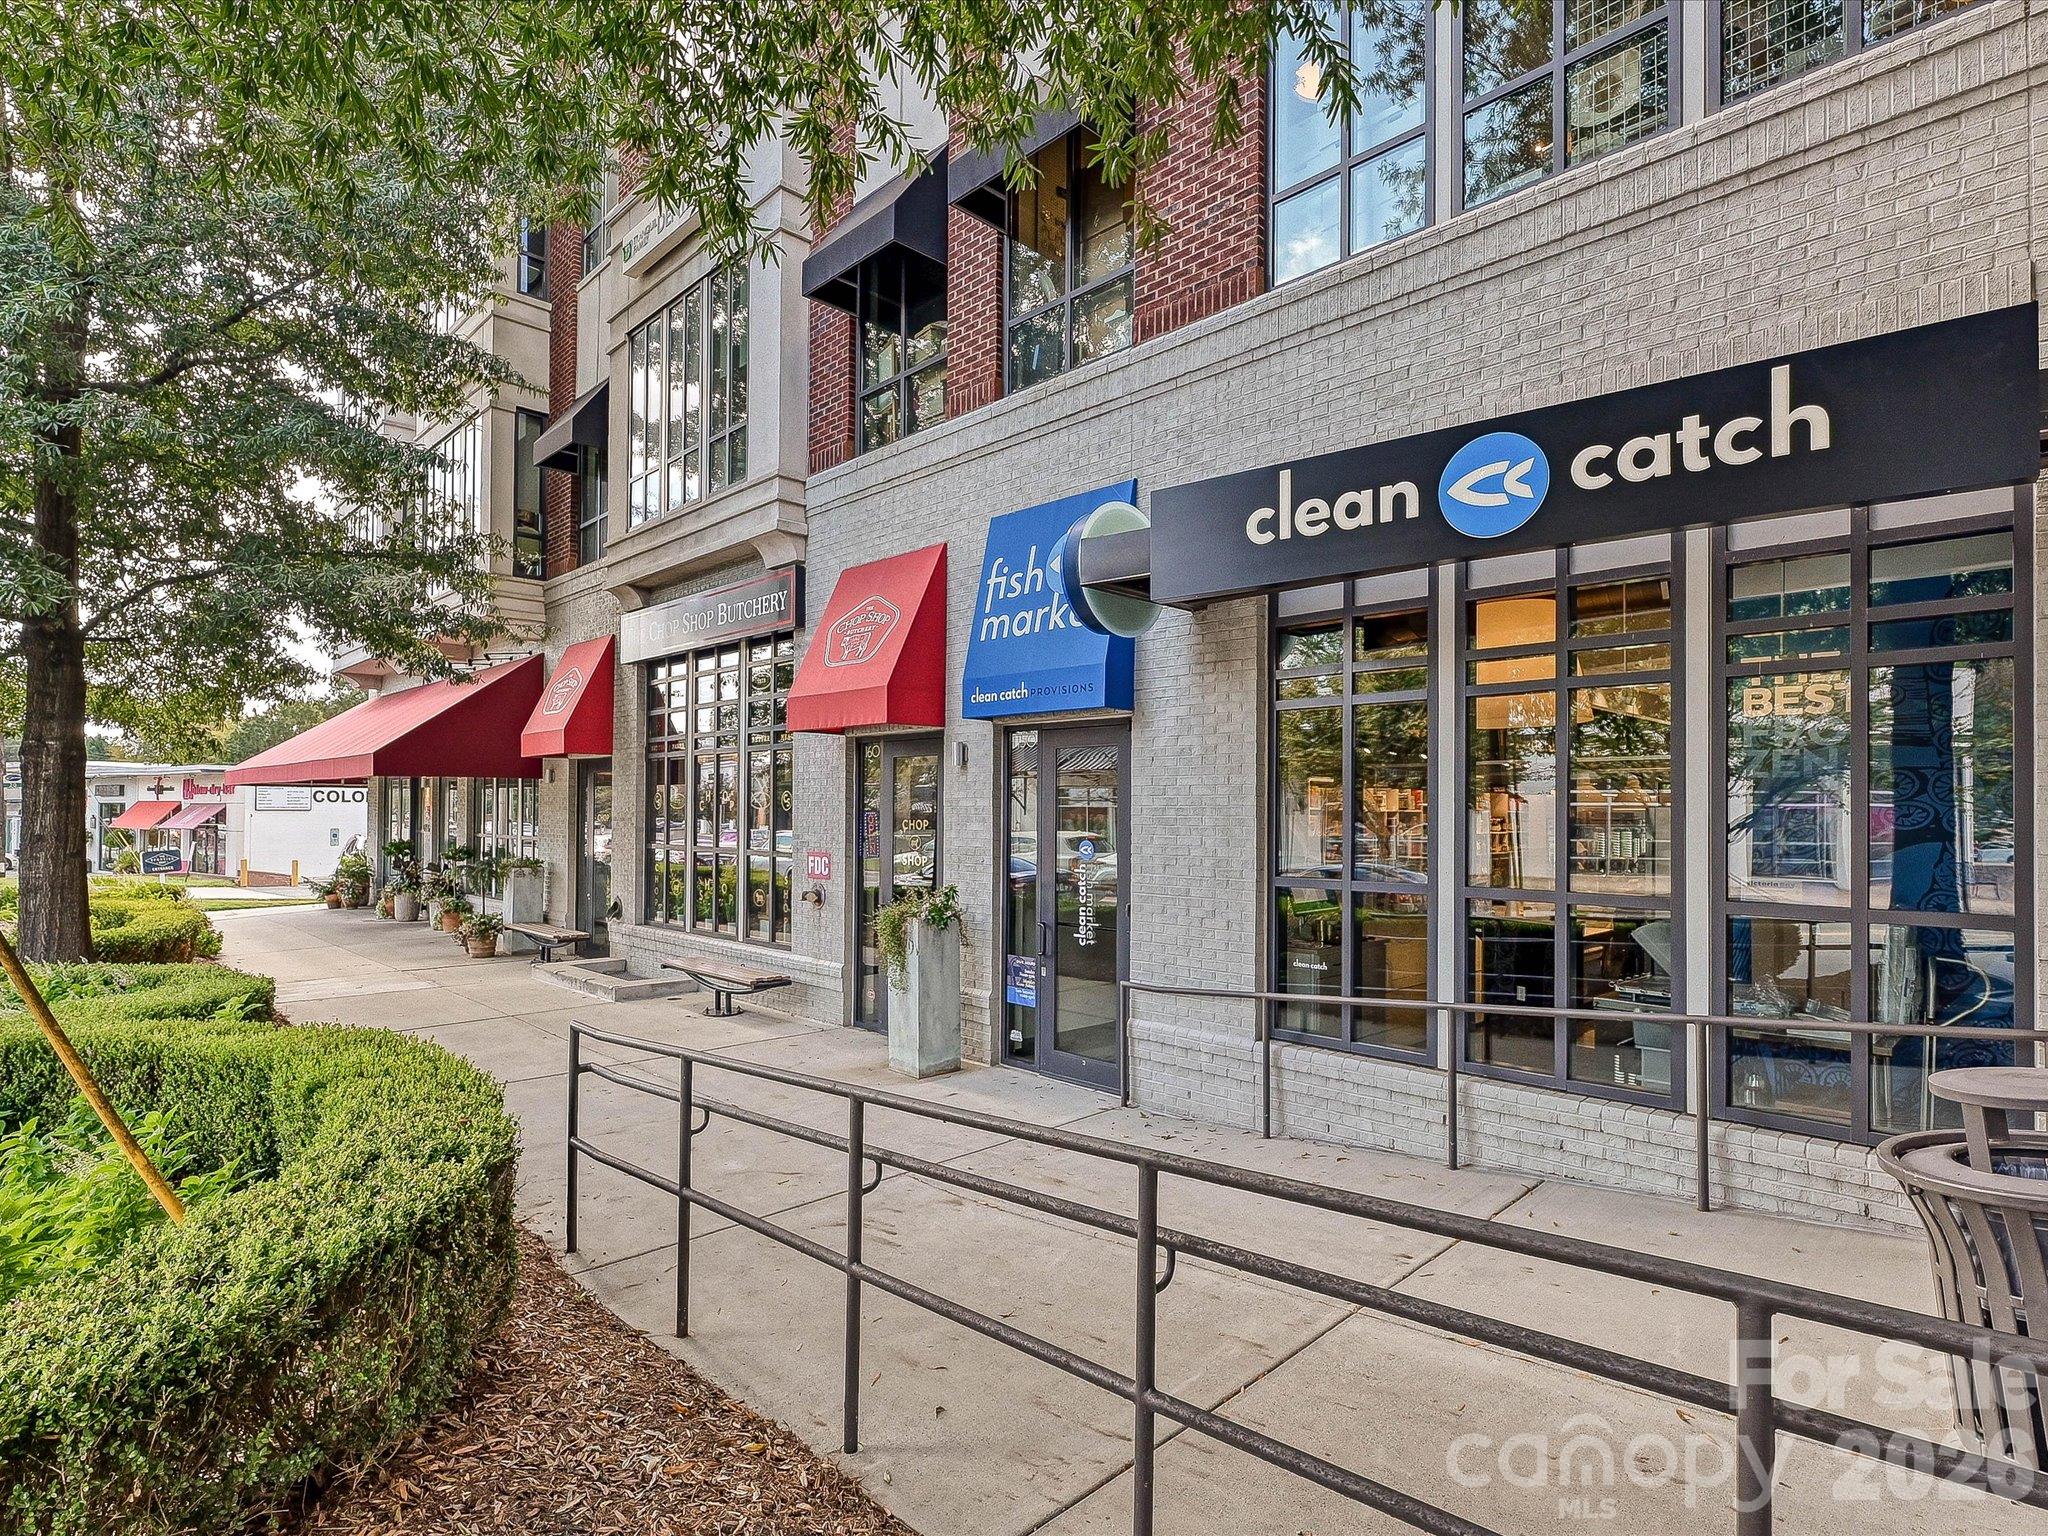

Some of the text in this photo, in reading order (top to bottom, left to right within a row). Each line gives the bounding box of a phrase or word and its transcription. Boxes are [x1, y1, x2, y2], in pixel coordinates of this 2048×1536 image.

[1245, 364, 1831, 545] clean catch
[984, 544, 1044, 614] fish
[649, 619, 680, 641] CHOP
[682, 610, 714, 634] SHOP
[717, 590, 788, 626] BUTCHERY
[837, 611, 892, 634] CHOP SHOP
[979, 592, 1083, 642] mark
[970, 682, 1094, 704] clean catch PROVISIONS
[1743, 682, 1851, 717] BEST
[865, 745, 880, 758] 160
[313, 790, 368, 803] COLO
[902, 819, 929, 831] CHOP
[808, 858, 829, 876] FDC
[901, 855, 928, 867] SHOP
[1073, 863, 1087, 946] clean catch
[1086, 893, 1101, 946] market
[1292, 958, 1328, 971] clean catch
